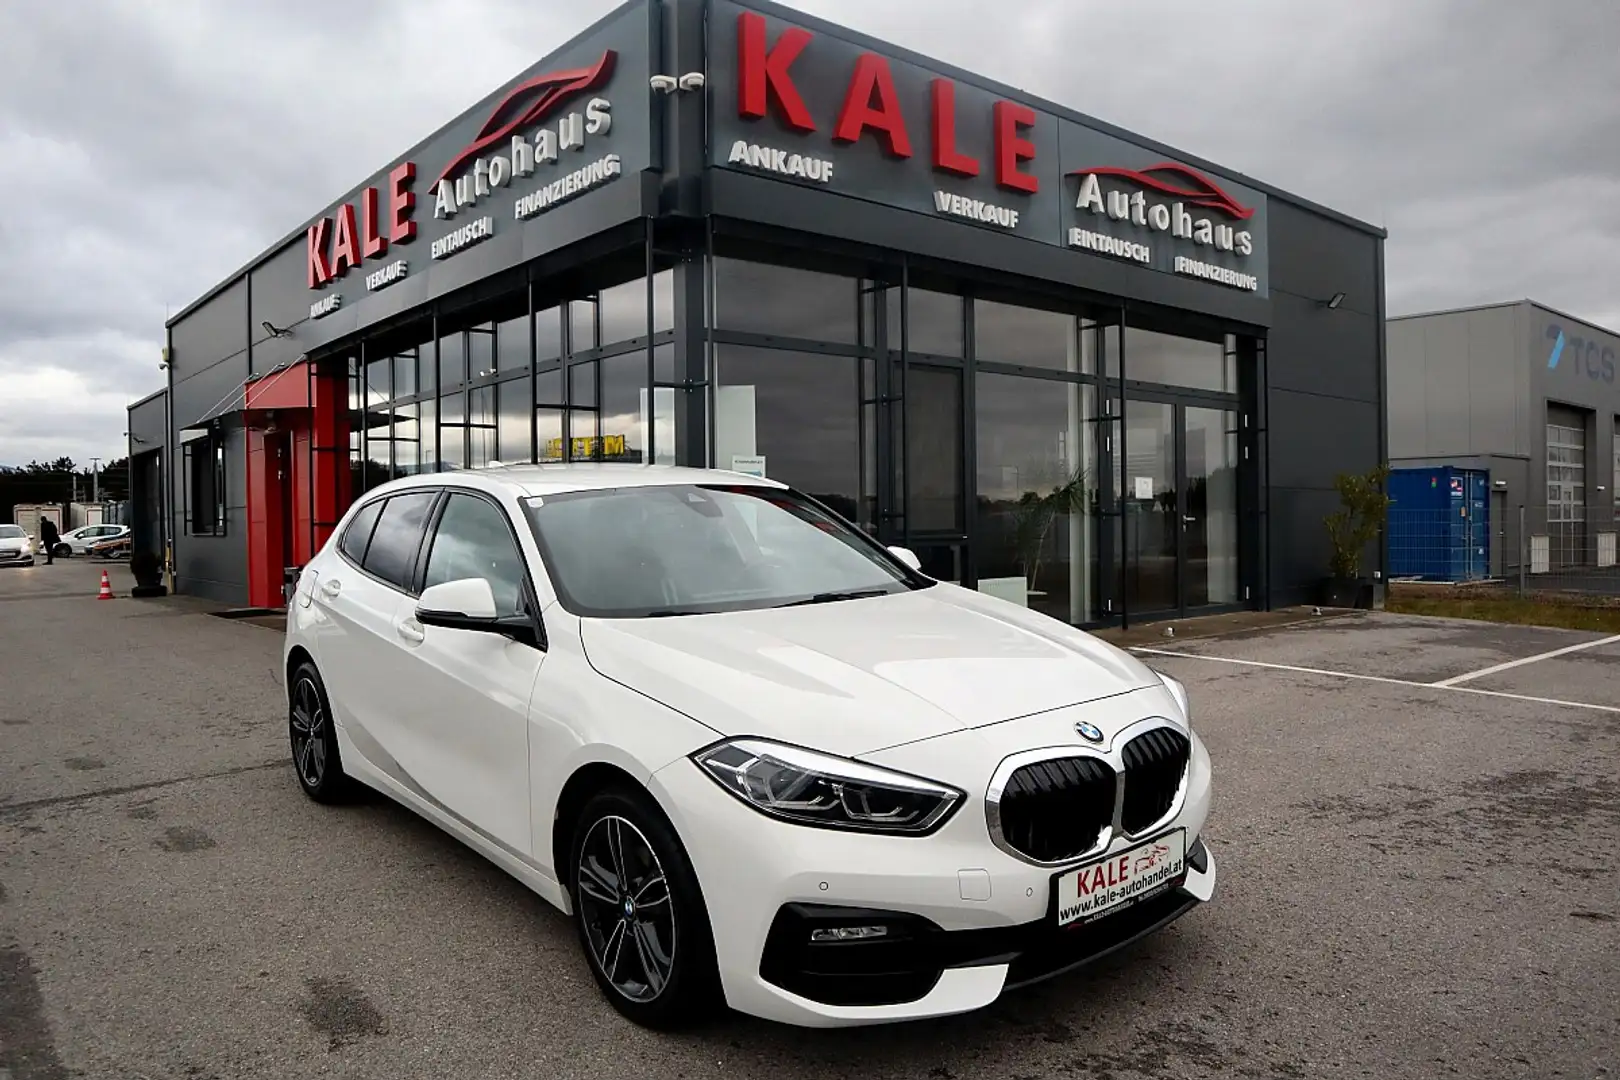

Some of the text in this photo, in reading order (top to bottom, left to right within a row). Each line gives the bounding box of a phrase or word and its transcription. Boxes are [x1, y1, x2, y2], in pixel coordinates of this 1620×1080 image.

[737, 11, 1038, 194] KALE
[434, 97, 612, 219] Autohaus
[728, 140, 833, 183] ANKAUF
[514, 154, 621, 220] FINANZIERUNG
[932, 190, 1019, 229] VERKAUF
[307, 161, 416, 290] KALE
[1075, 173, 1253, 256] Autohaus
[431, 216, 493, 260] EINTAUSCH
[1068, 227, 1150, 263] EINTAUSCH
[365, 259, 408, 292] VERKAUF
[1174, 255, 1257, 292] FINANZIERUNG
[1570, 337, 1615, 384] TCS
[1059, 858, 1183, 921] www.kale-autohandel.at
[1077, 856, 1130, 898] KALE
